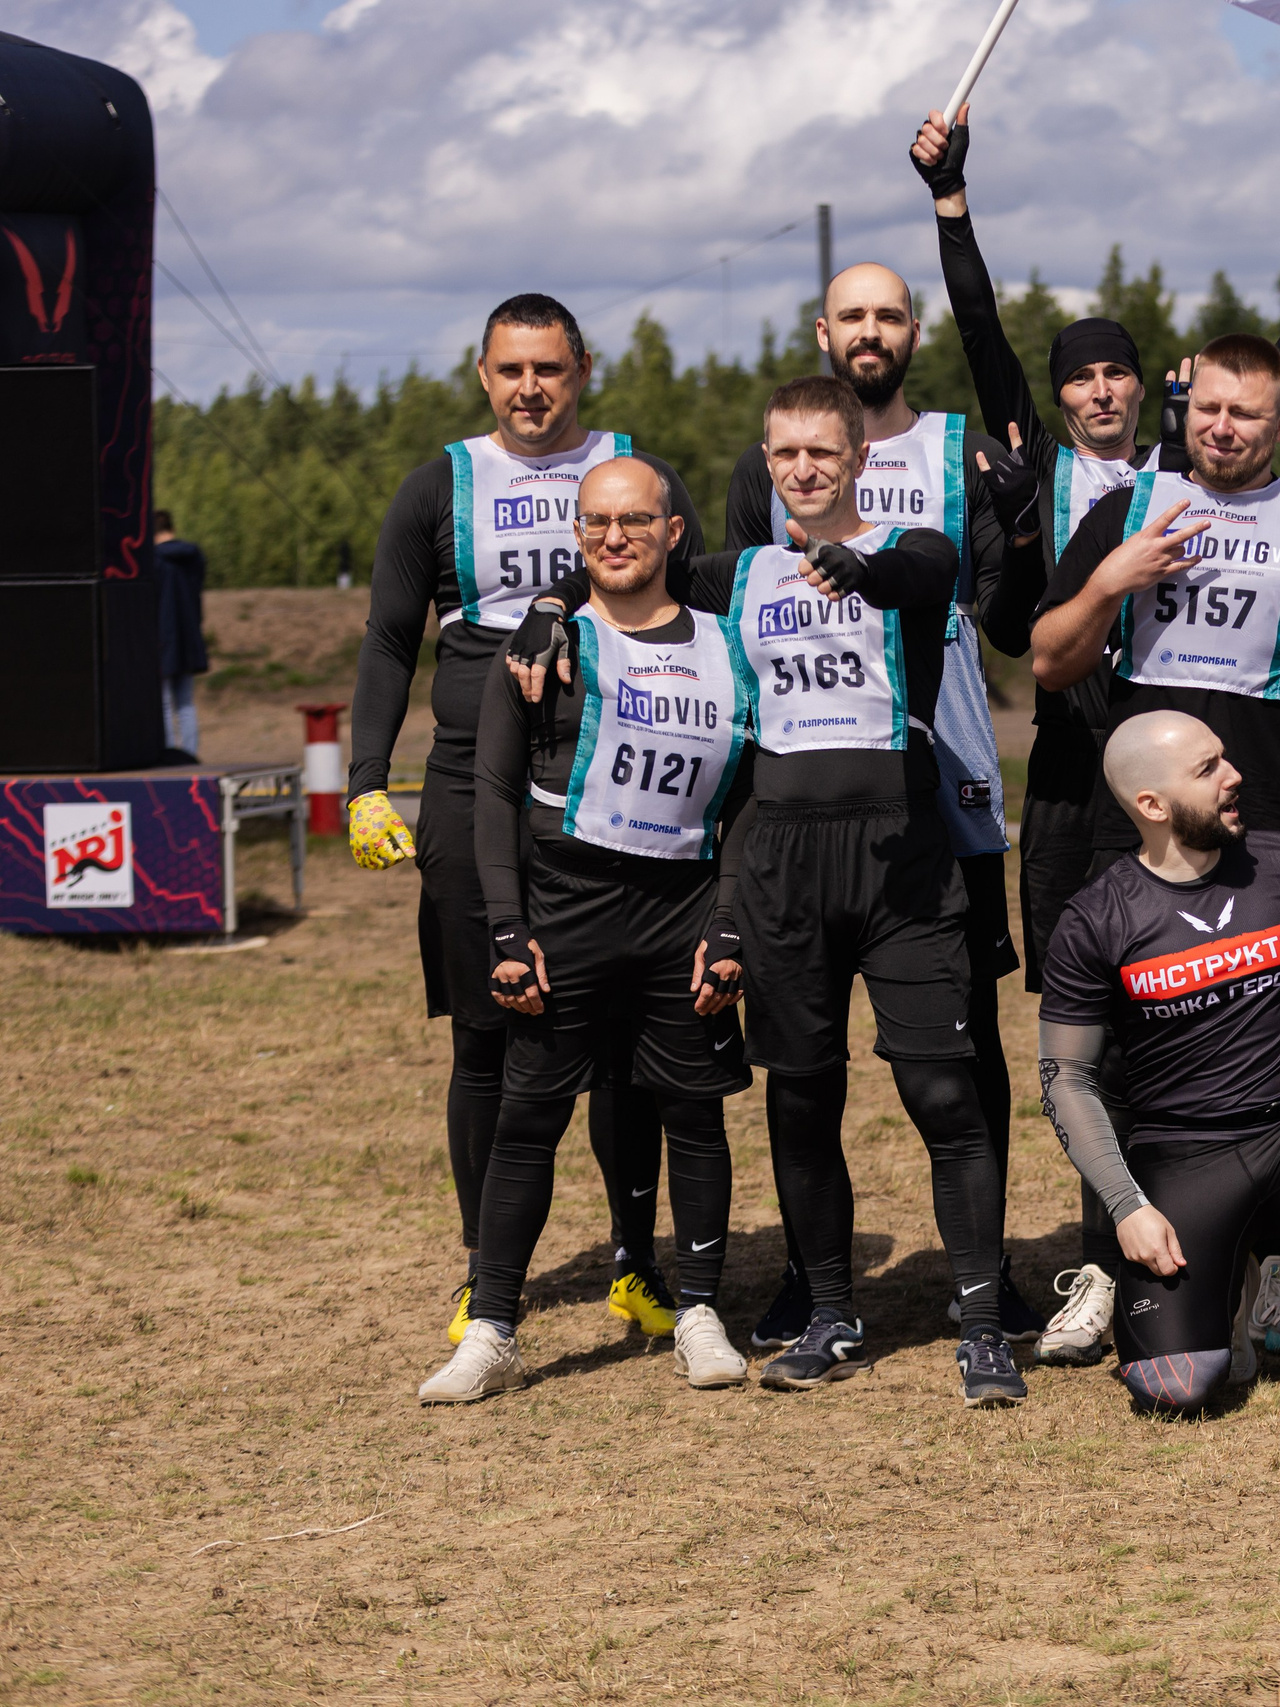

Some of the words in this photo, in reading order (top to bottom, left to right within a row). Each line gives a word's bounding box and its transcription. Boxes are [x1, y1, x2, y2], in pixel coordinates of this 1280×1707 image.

[869, 460, 906, 468] ГЕРОЕВ
[510, 473, 540, 485] ГОНКА
[543, 472, 579, 482] ГЕРОЕВ
[859, 488, 924, 515] DVIG
[1185, 508, 1216, 517] ГОНКА
[1219, 510, 1257, 522] ГЕРОЕВ
[1180, 535, 1270, 564] ODVIG
[761, 596, 862, 633] RODVIG
[1154, 582, 1257, 630] 5157
[628, 665, 660, 675] ГОНКА
[663, 665, 698, 678] ГЕРОЕВ
[771, 651, 866, 697] 5163
[1178, 653, 1238, 668] ГАЗПРОМБАНК
[621, 686, 718, 730] RODVIG
[798, 717, 858, 729] ГАЗПРОМБАНК
[611, 742, 703, 798] 6121
[628, 818, 683, 836] ГАЗПРОМБАНК
[1142, 991, 1221, 1020] ГОНКА
